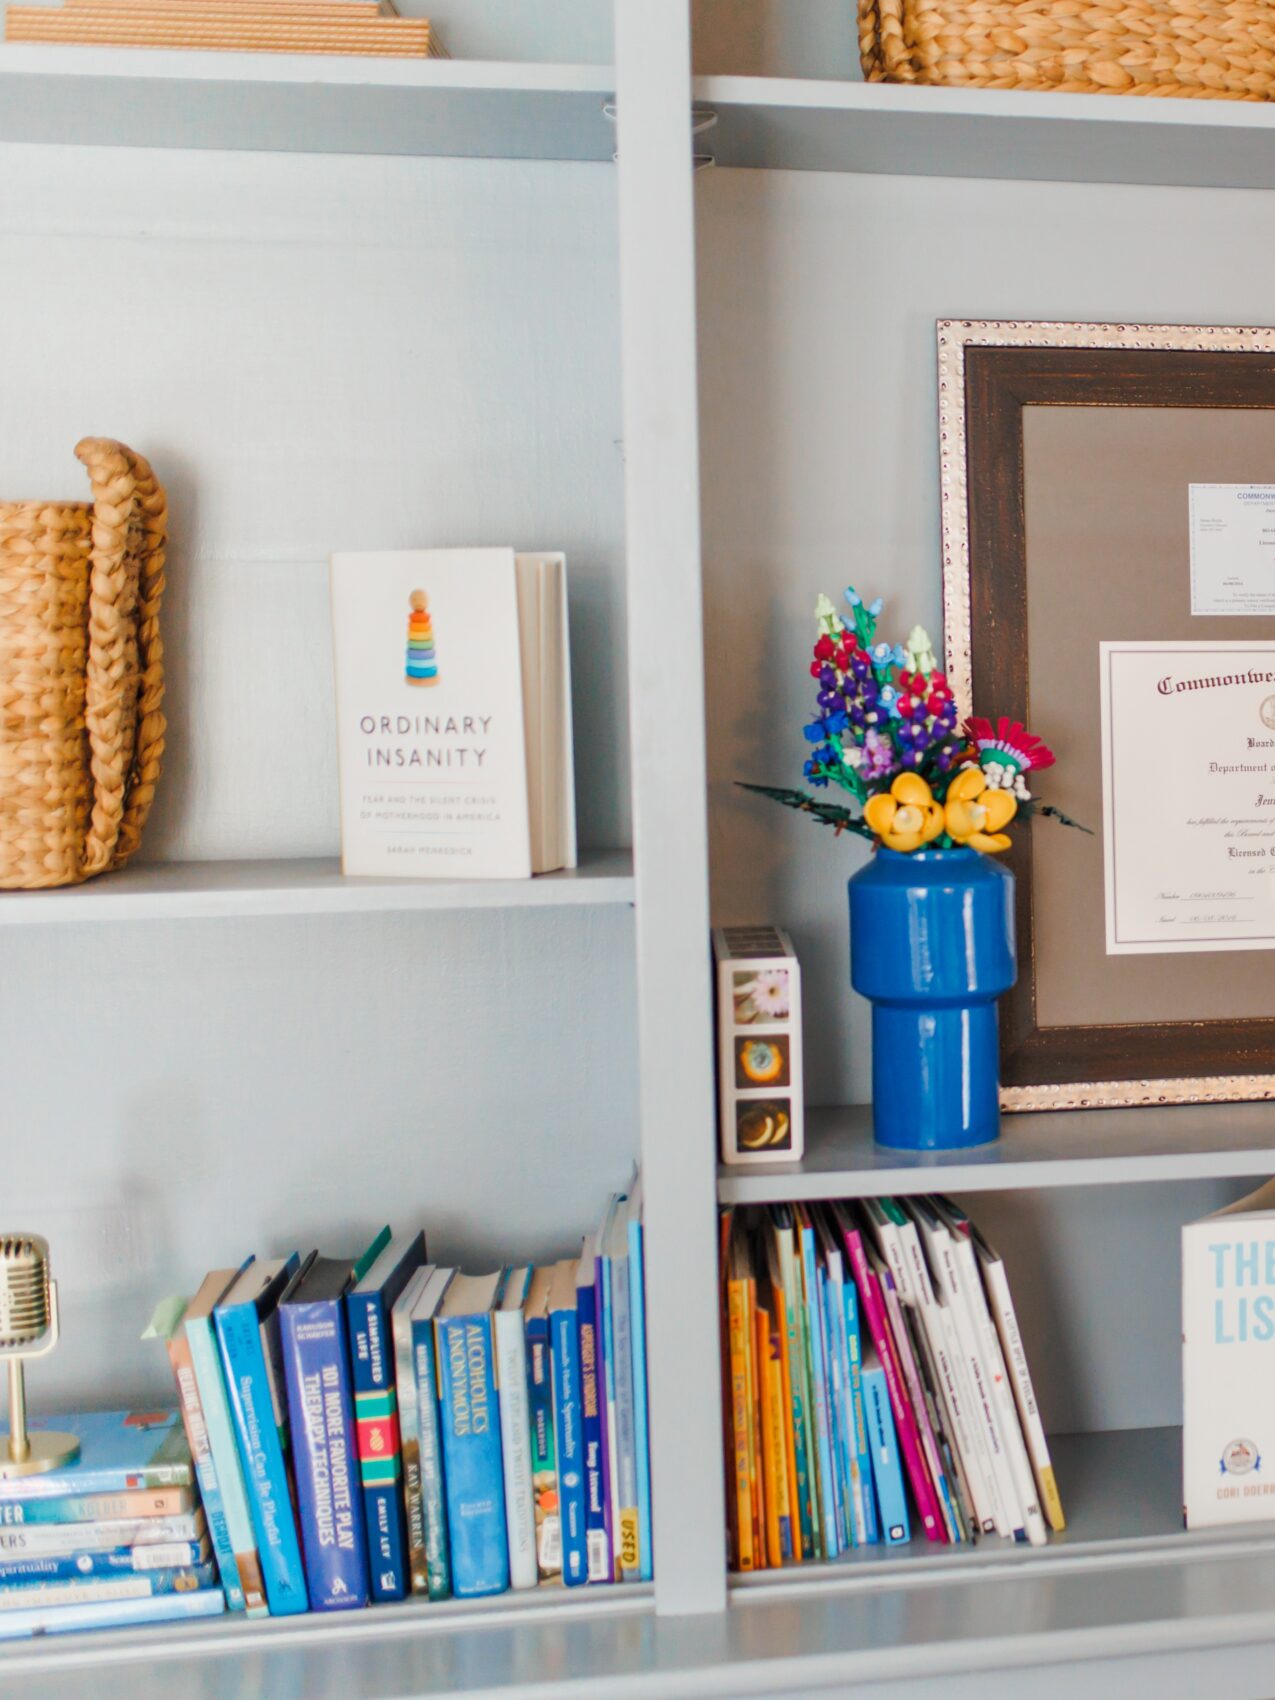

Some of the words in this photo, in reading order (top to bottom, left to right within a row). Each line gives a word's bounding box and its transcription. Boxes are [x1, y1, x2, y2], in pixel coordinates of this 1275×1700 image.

[360, 716, 493, 735] ORDINARY
[1247, 737, 1275, 748] Board
[367, 748, 487, 768] INSANITY
[1208, 762, 1267, 774] Department
[360, 812, 372, 820] OF
[375, 812, 440, 821] MOTHERHOOD
[443, 812, 453, 821] IN
[456, 812, 502, 821] AMERICA
[362, 796, 384, 804] FEAR
[388, 796, 407, 804] AND
[410, 796, 426, 805] THE
[429, 796, 461, 805] SILENT
[464, 796, 496, 805] CRISIS
[1228, 847, 1266, 859] Licensed
[366, 1302, 375, 1312] A
[357, 1332, 368, 1360] LIFE
[366, 1315, 382, 1382] SIMPLIFIED
[579, 1324, 596, 1371] ASPERGER'S
[1004, 1318, 1018, 1344] LITTLE
[322, 1365, 338, 1387] 101
[448, 1326, 470, 1437] ANONYMOUS
[466, 1324, 490, 1435] ALCOHOLICS
[241, 1376, 261, 1449] Supervision
[305, 1374, 326, 1444] THERAPY
[582, 1374, 598, 1417] SYNDROME
[324, 1392, 343, 1436] MORE
[560, 1401, 576, 1458] Spirituality
[511, 1421, 522, 1445] AND
[535, 1410, 547, 1456] WORKBOOK
[254, 1452, 268, 1477] Can
[512, 1446, 524, 1486] TWELVE
[586, 1441, 599, 1468] Tony
[260, 1481, 273, 1498] Be
[329, 1440, 350, 1508] FAVORITE
[407, 1464, 418, 1490] KAY
[588, 1470, 602, 1512] Attwood
[310, 1451, 335, 1545] TECHNIQUES
[1217, 1487, 1240, 1500] CORI
[212, 1511, 232, 1555] DEGROAT
[262, 1501, 281, 1545] Playful
[336, 1513, 353, 1549] PLAY
[375, 1497, 389, 1533] EMILY
[409, 1494, 424, 1548] WARREN
[514, 1488, 529, 1552] TRADITIONS
[379, 1536, 390, 1560] LEY
[620, 1519, 638, 1563] USED
